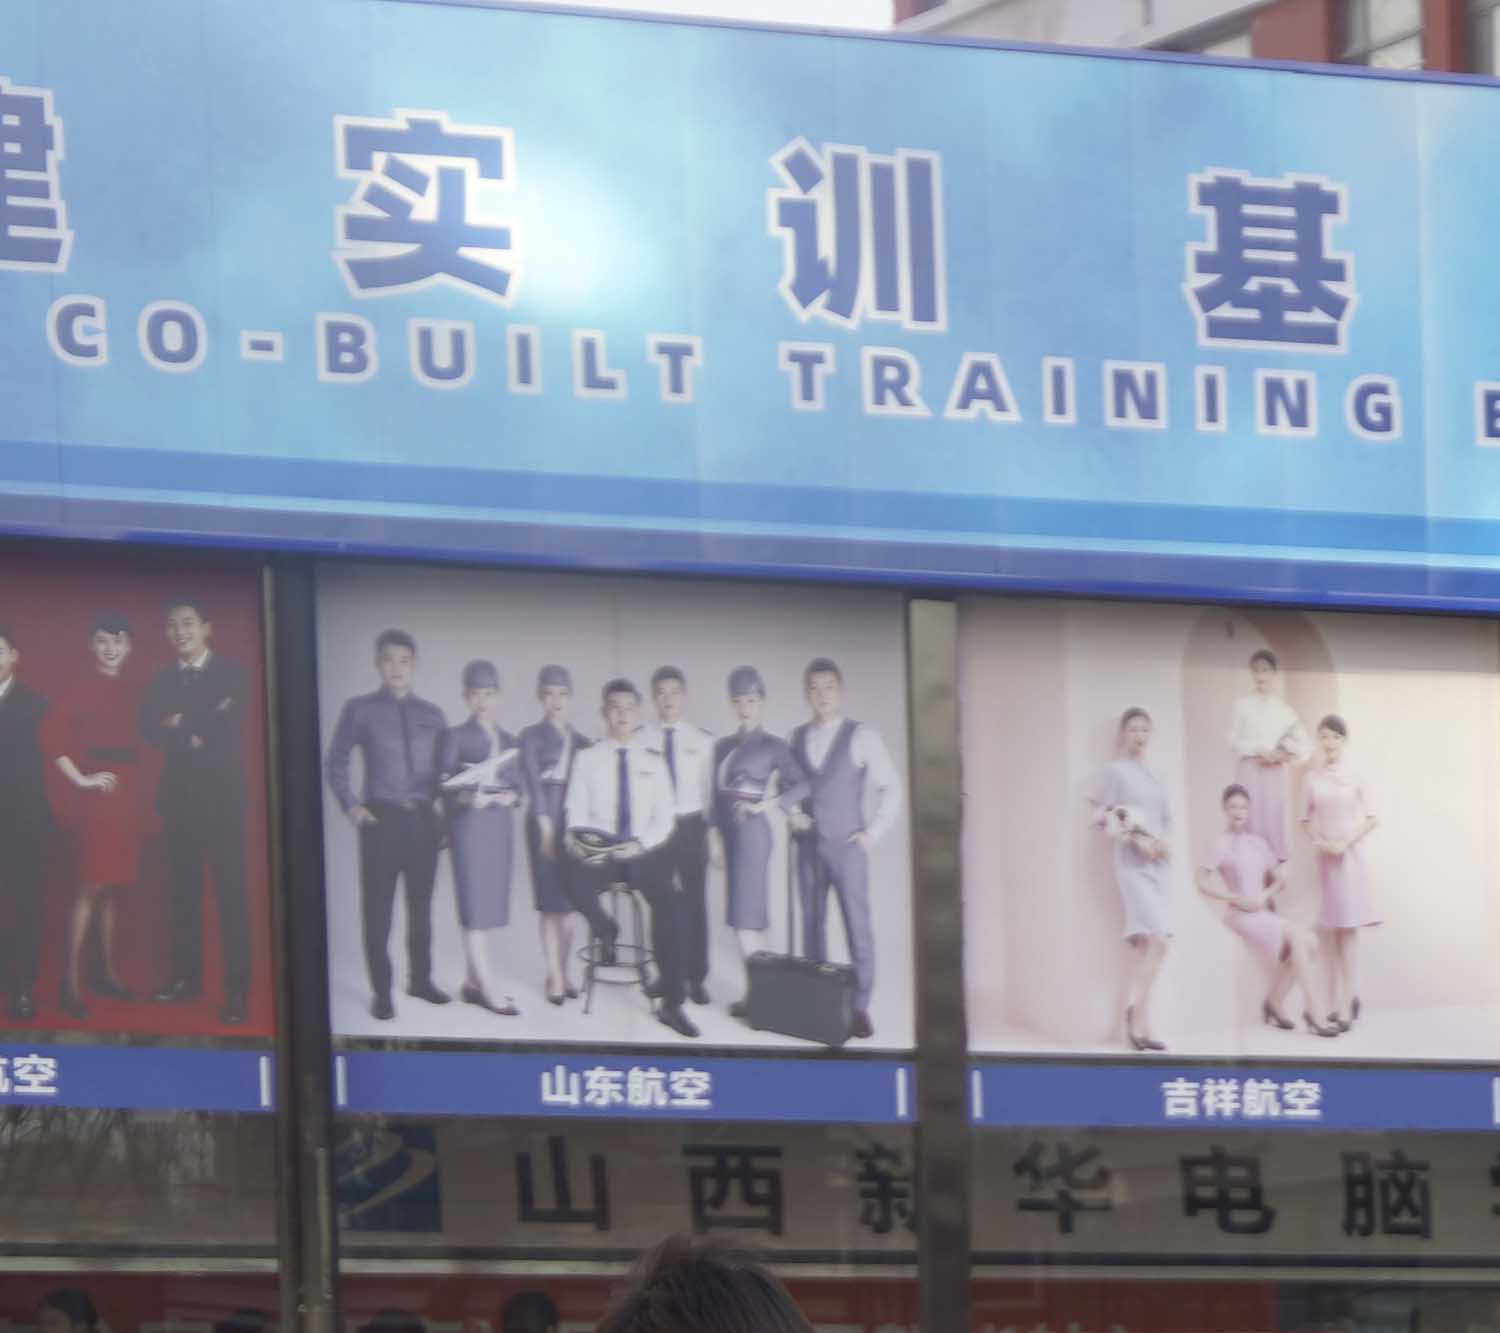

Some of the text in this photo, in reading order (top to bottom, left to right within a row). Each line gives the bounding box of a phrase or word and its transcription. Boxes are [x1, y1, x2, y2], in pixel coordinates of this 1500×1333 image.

[47, 293, 703, 404] CO-BUILT
[779, 341, 1402, 441] TRAINING
[0, 1054, 58, 1098] 空
[540, 1065, 713, 1112] 山东航空
[1162, 1077, 1322, 1121] 吉祥航空
